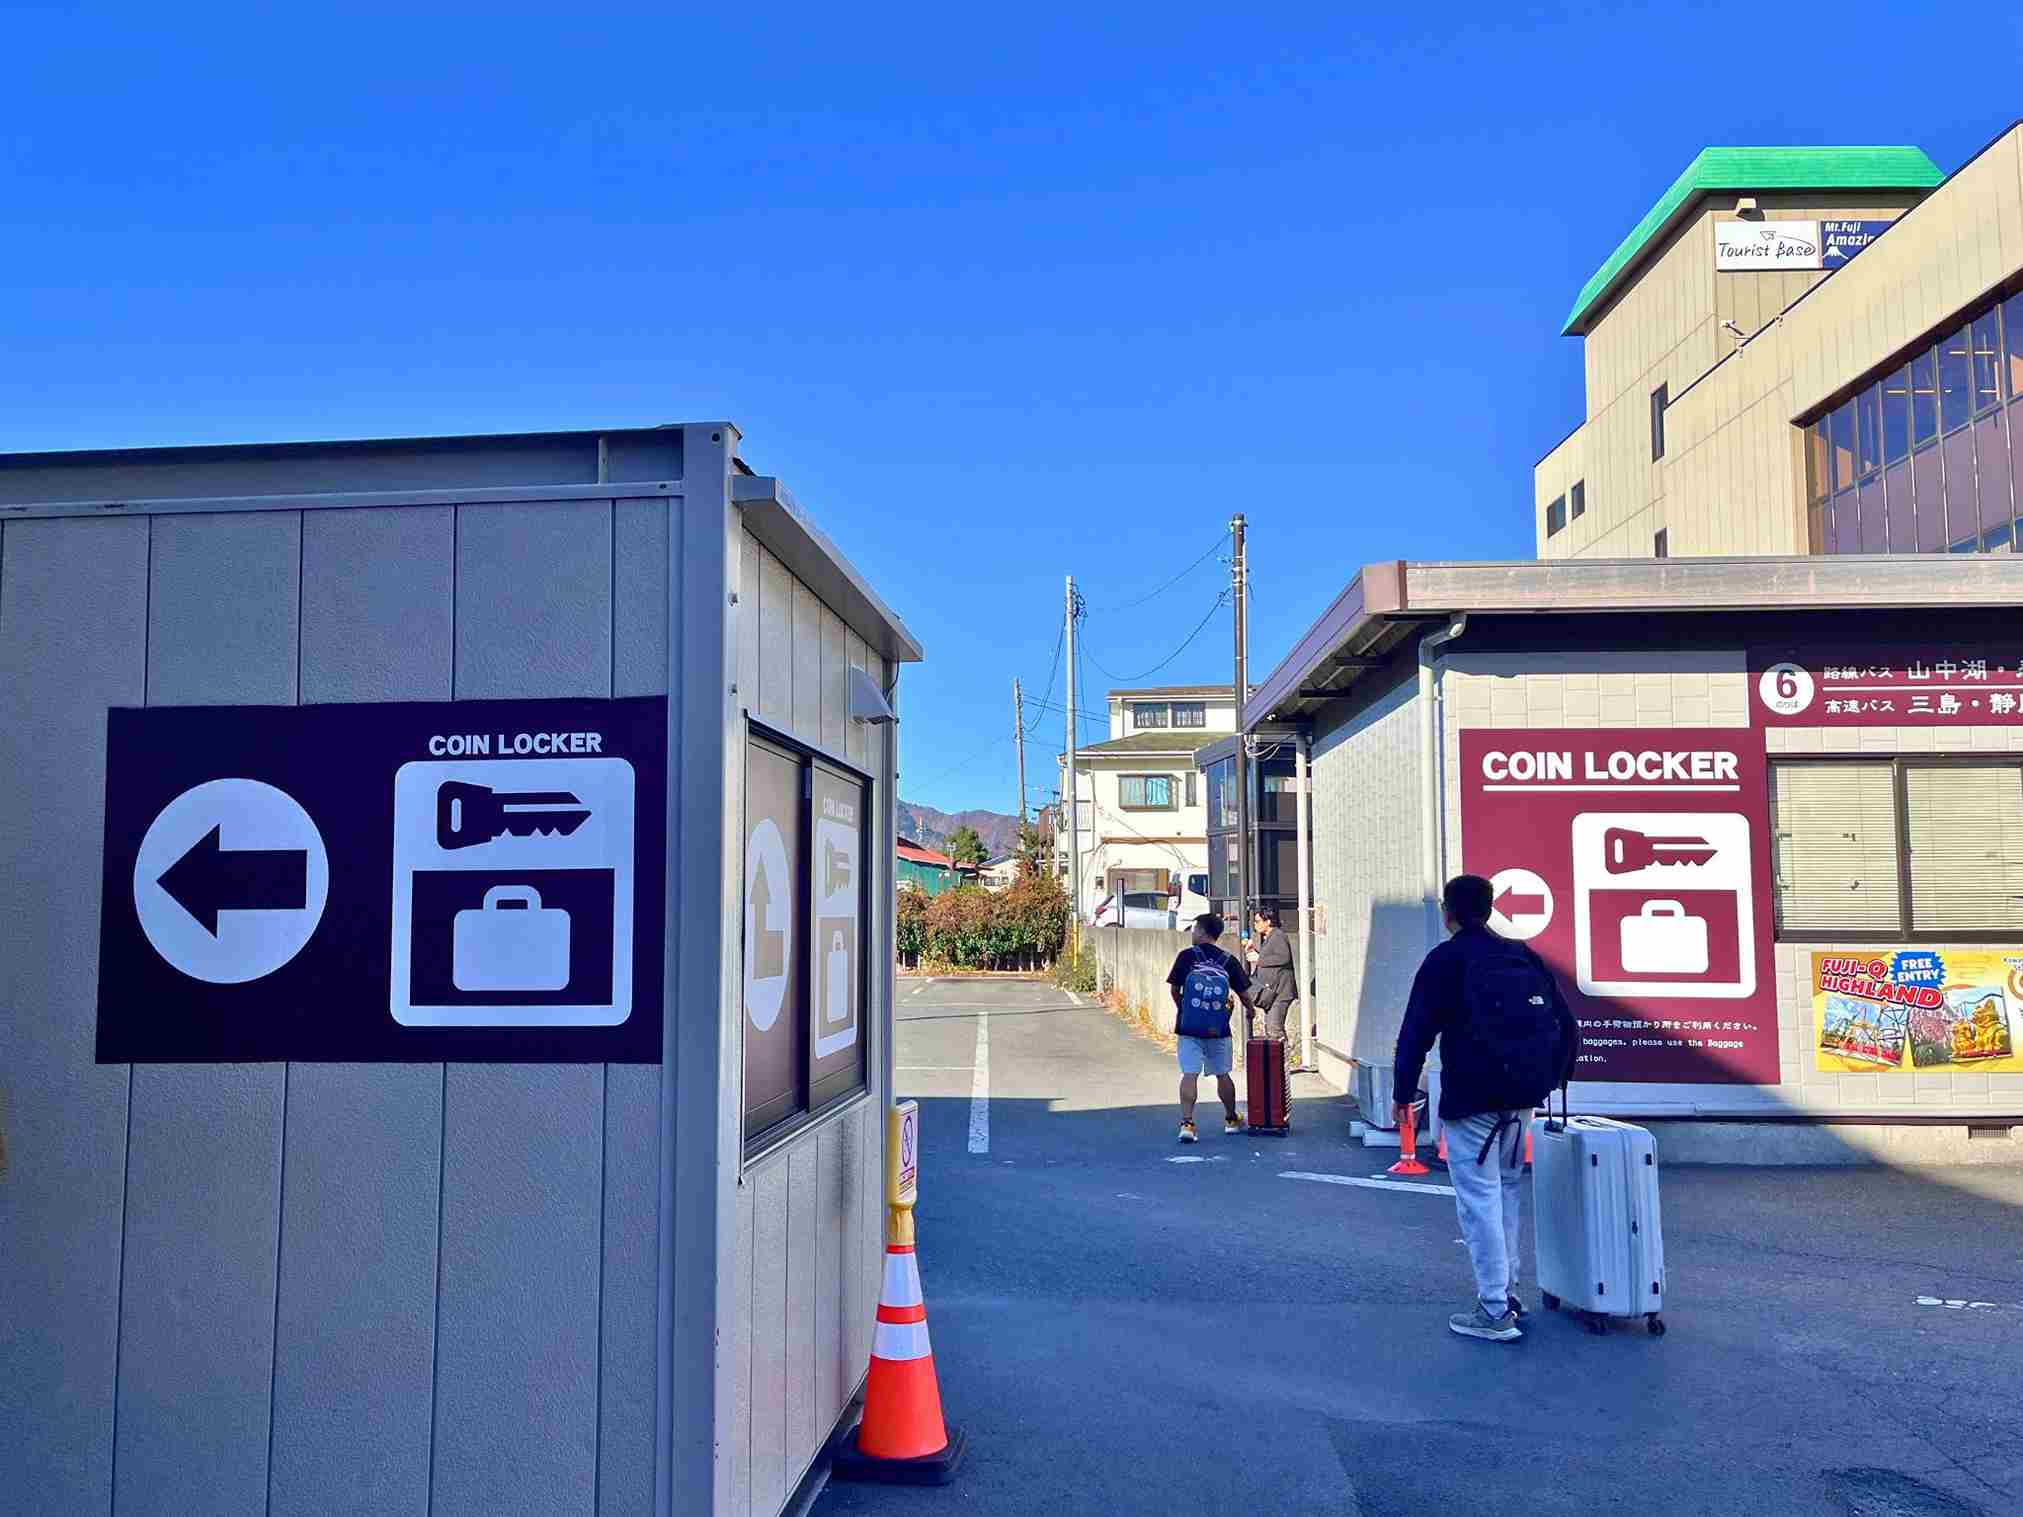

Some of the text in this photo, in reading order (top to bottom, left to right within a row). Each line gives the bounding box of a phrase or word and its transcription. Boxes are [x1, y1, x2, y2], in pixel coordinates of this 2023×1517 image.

[1718, 241, 1813, 259] Tourist Base
[1775, 668, 1798, 699] 6
[1823, 665, 1893, 680] 路線バス
[1825, 693, 2023, 715] 高速バス 三島・静
[428, 732, 602, 756] COIN LOCKER
[1482, 751, 1739, 780] COIN LOCKER
[1821, 958, 1888, 981] FUJI-Q
[1901, 958, 1933, 969] FREE
[1897, 969, 1940, 982] ENTRY
[1820, 974, 1944, 1009] HIGHLAND
[1631, 1038, 1663, 1048] please
[1688, 1039, 1703, 1047] the
